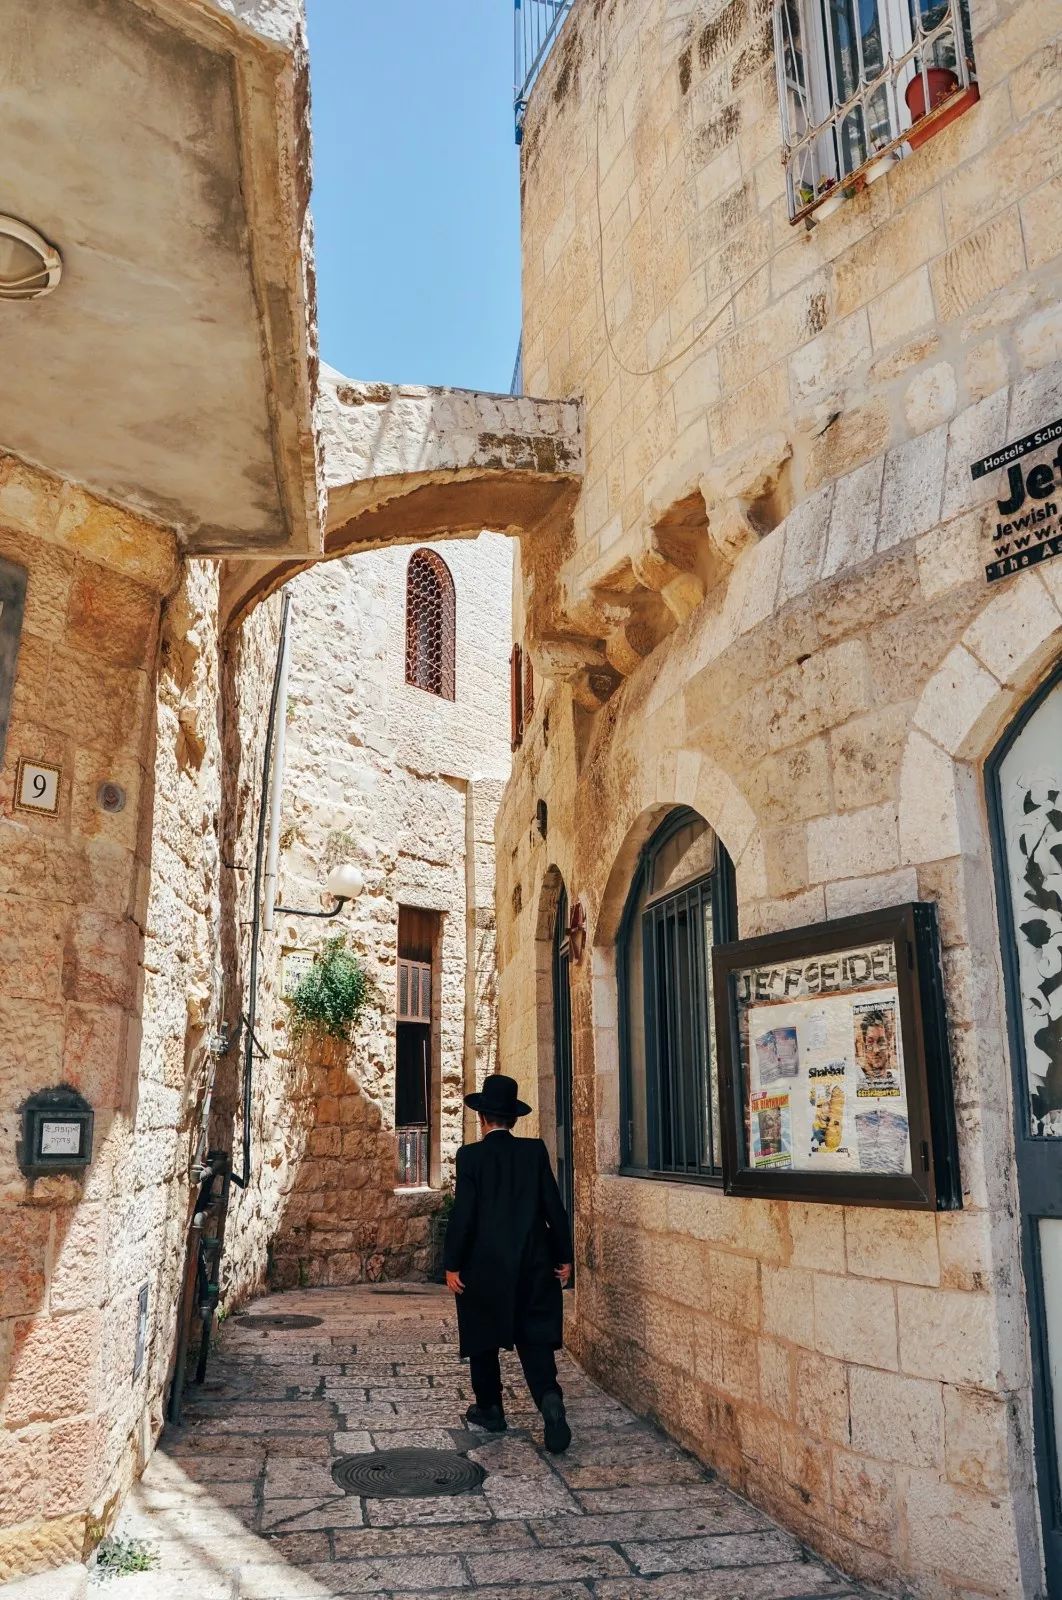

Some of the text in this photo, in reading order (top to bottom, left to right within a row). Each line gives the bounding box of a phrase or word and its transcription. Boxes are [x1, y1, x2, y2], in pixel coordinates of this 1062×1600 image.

[983, 444, 1024, 471] Hostels
[993, 502, 1057, 541] Jewish
[997, 555, 1029, 577] The
[32, 774, 46, 798] 9
[804, 945, 897, 994] SEIDEL
